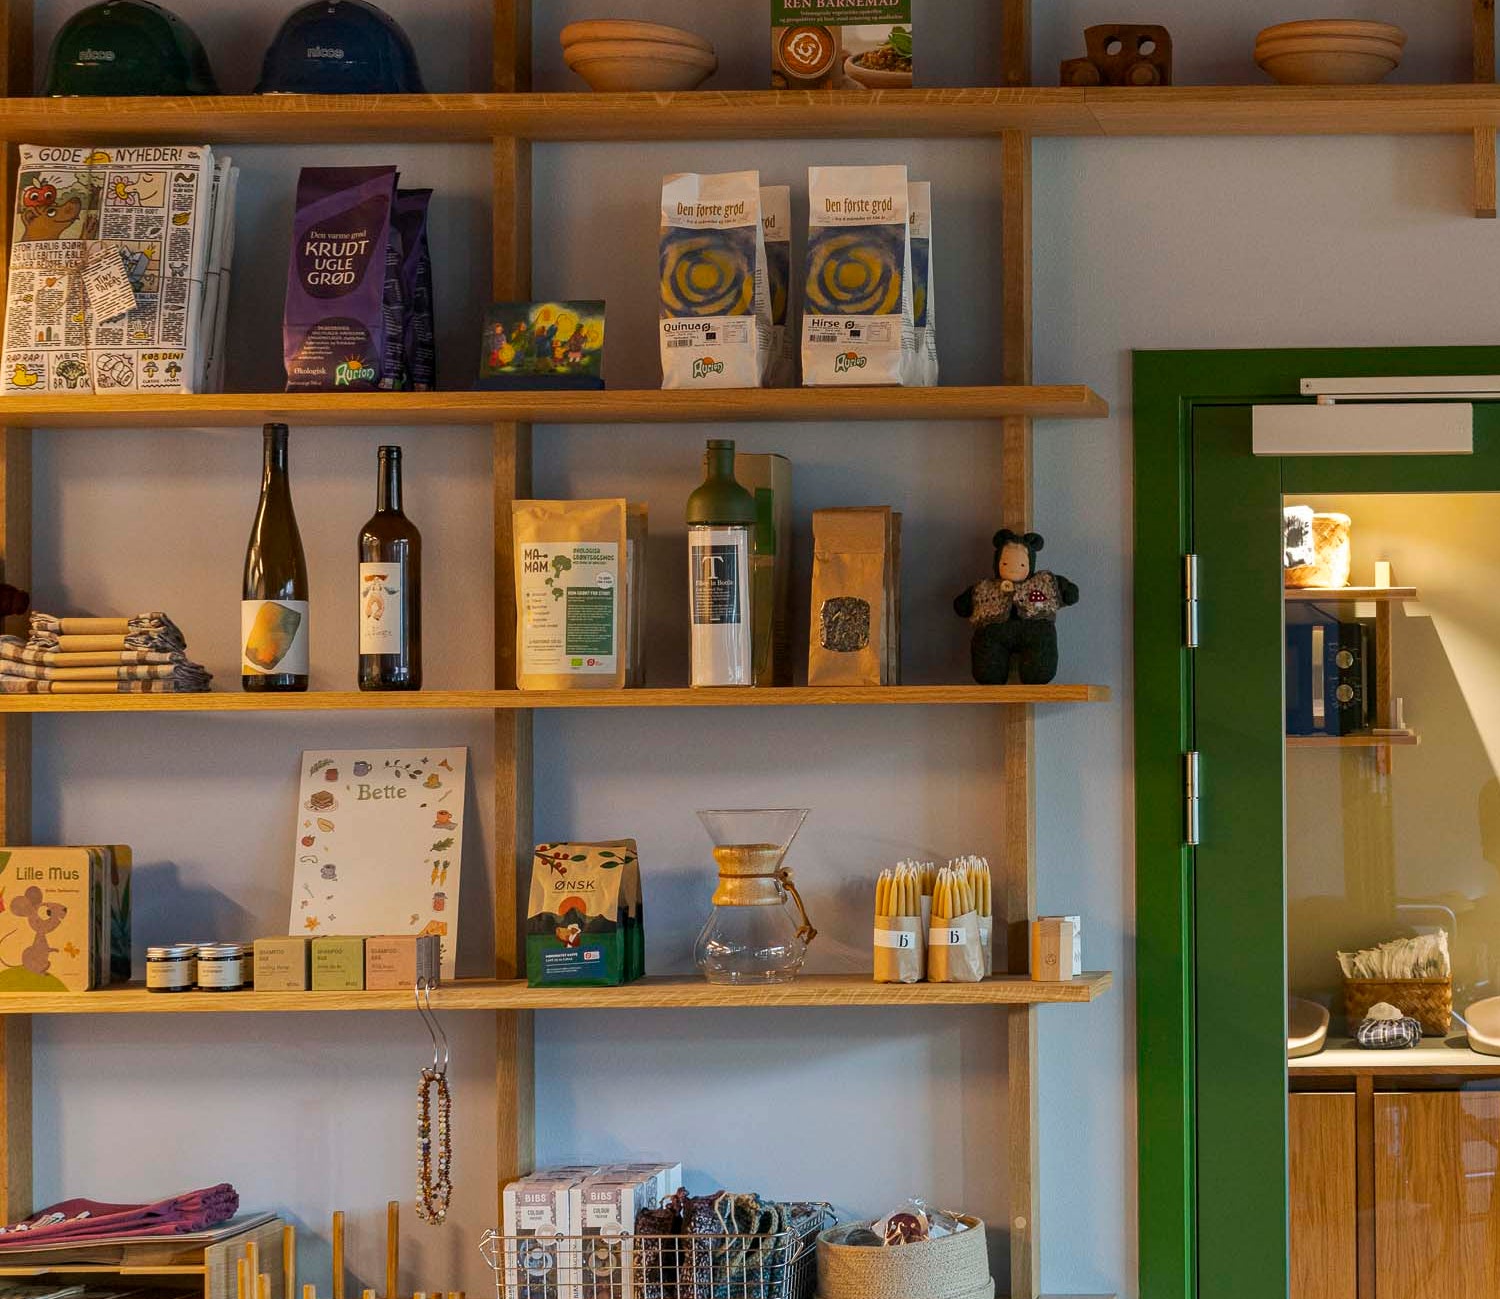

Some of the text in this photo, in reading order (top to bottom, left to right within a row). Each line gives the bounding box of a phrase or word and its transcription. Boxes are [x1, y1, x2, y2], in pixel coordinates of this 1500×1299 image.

[39, 148, 183, 163] GODE NYHEDER!
[677, 201, 745, 218] Den første grød
[825, 196, 892, 214] Den første grød
[761, 214, 776, 229] rød
[310, 231, 326, 240] Den
[305, 240, 370, 257] KRUDT
[314, 258, 354, 271] UGLE
[94, 271, 112, 285] TINY
[95, 276, 122, 292] PAPERS
[307, 271, 355, 286] GRØD
[663, 322, 701, 332] Quinua
[811, 318, 840, 328] Hirse
[55, 352, 87, 361] MERE
[335, 362, 375, 386] Aurion
[524, 561, 549, 573] MAM
[702, 556, 724, 580] T
[357, 784, 408, 801] Bette
[16, 867, 80, 881] Lille Mus
[554, 880, 595, 891] ØNSK
[525, 1193, 546, 1203] BIBS
[591, 1191, 612, 1201] BIBS
